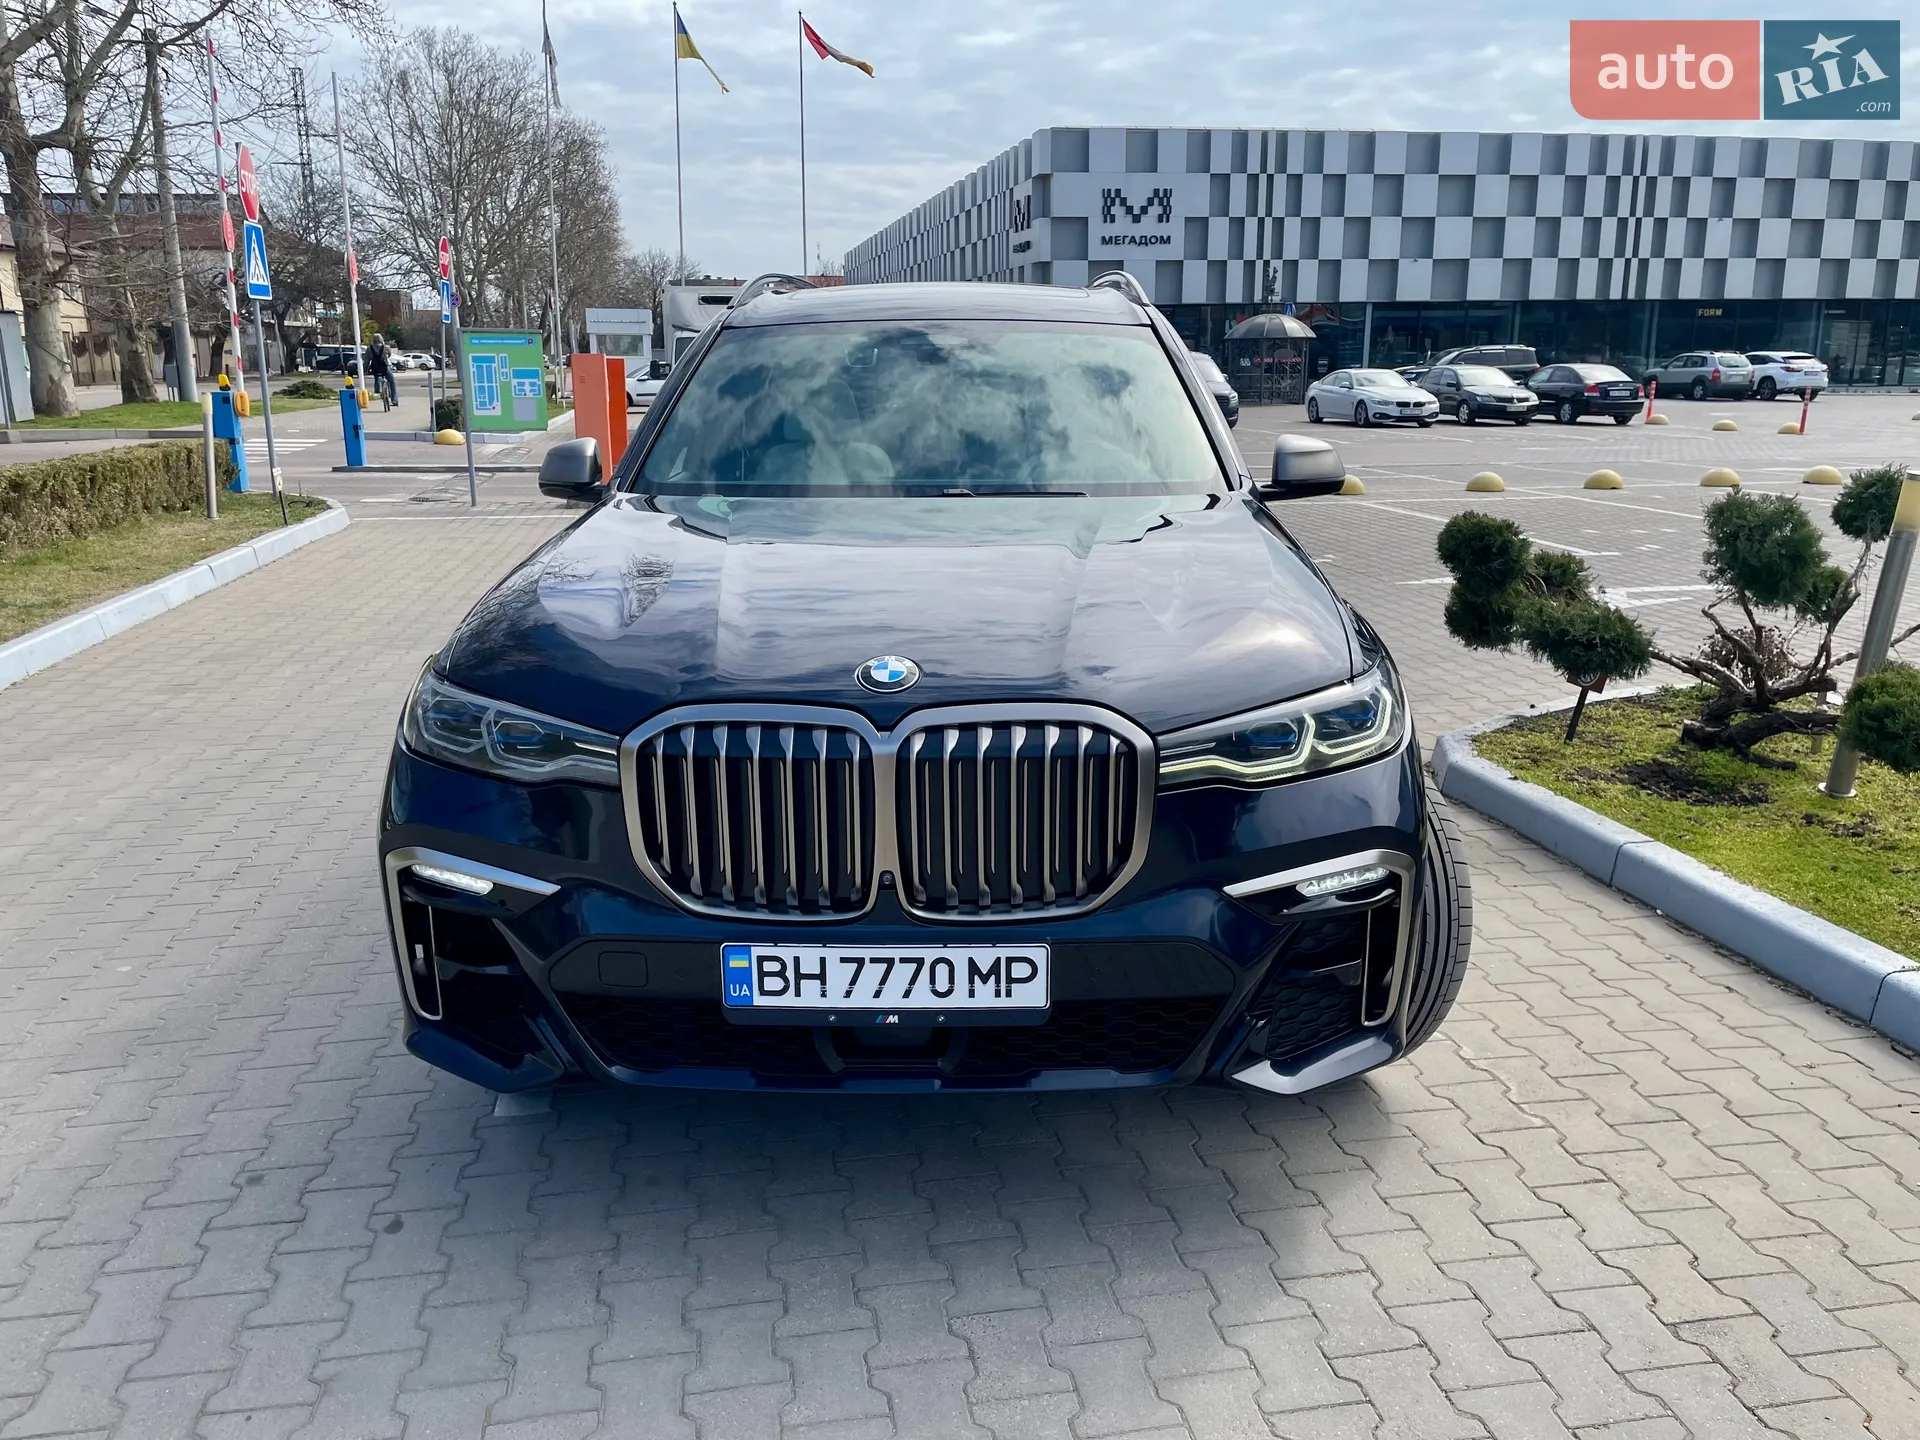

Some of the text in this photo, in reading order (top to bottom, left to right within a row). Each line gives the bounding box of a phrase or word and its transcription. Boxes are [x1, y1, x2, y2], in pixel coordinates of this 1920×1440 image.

[241, 168, 257, 197] STOP
[1101, 234, 1172, 247] МЕГАДОМ
[1698, 308, 1723, 317] FORM
[866, 655, 914, 667] BMW
[756, 955, 1039, 999] BH 7770 MP
[730, 984, 751, 997] UA
